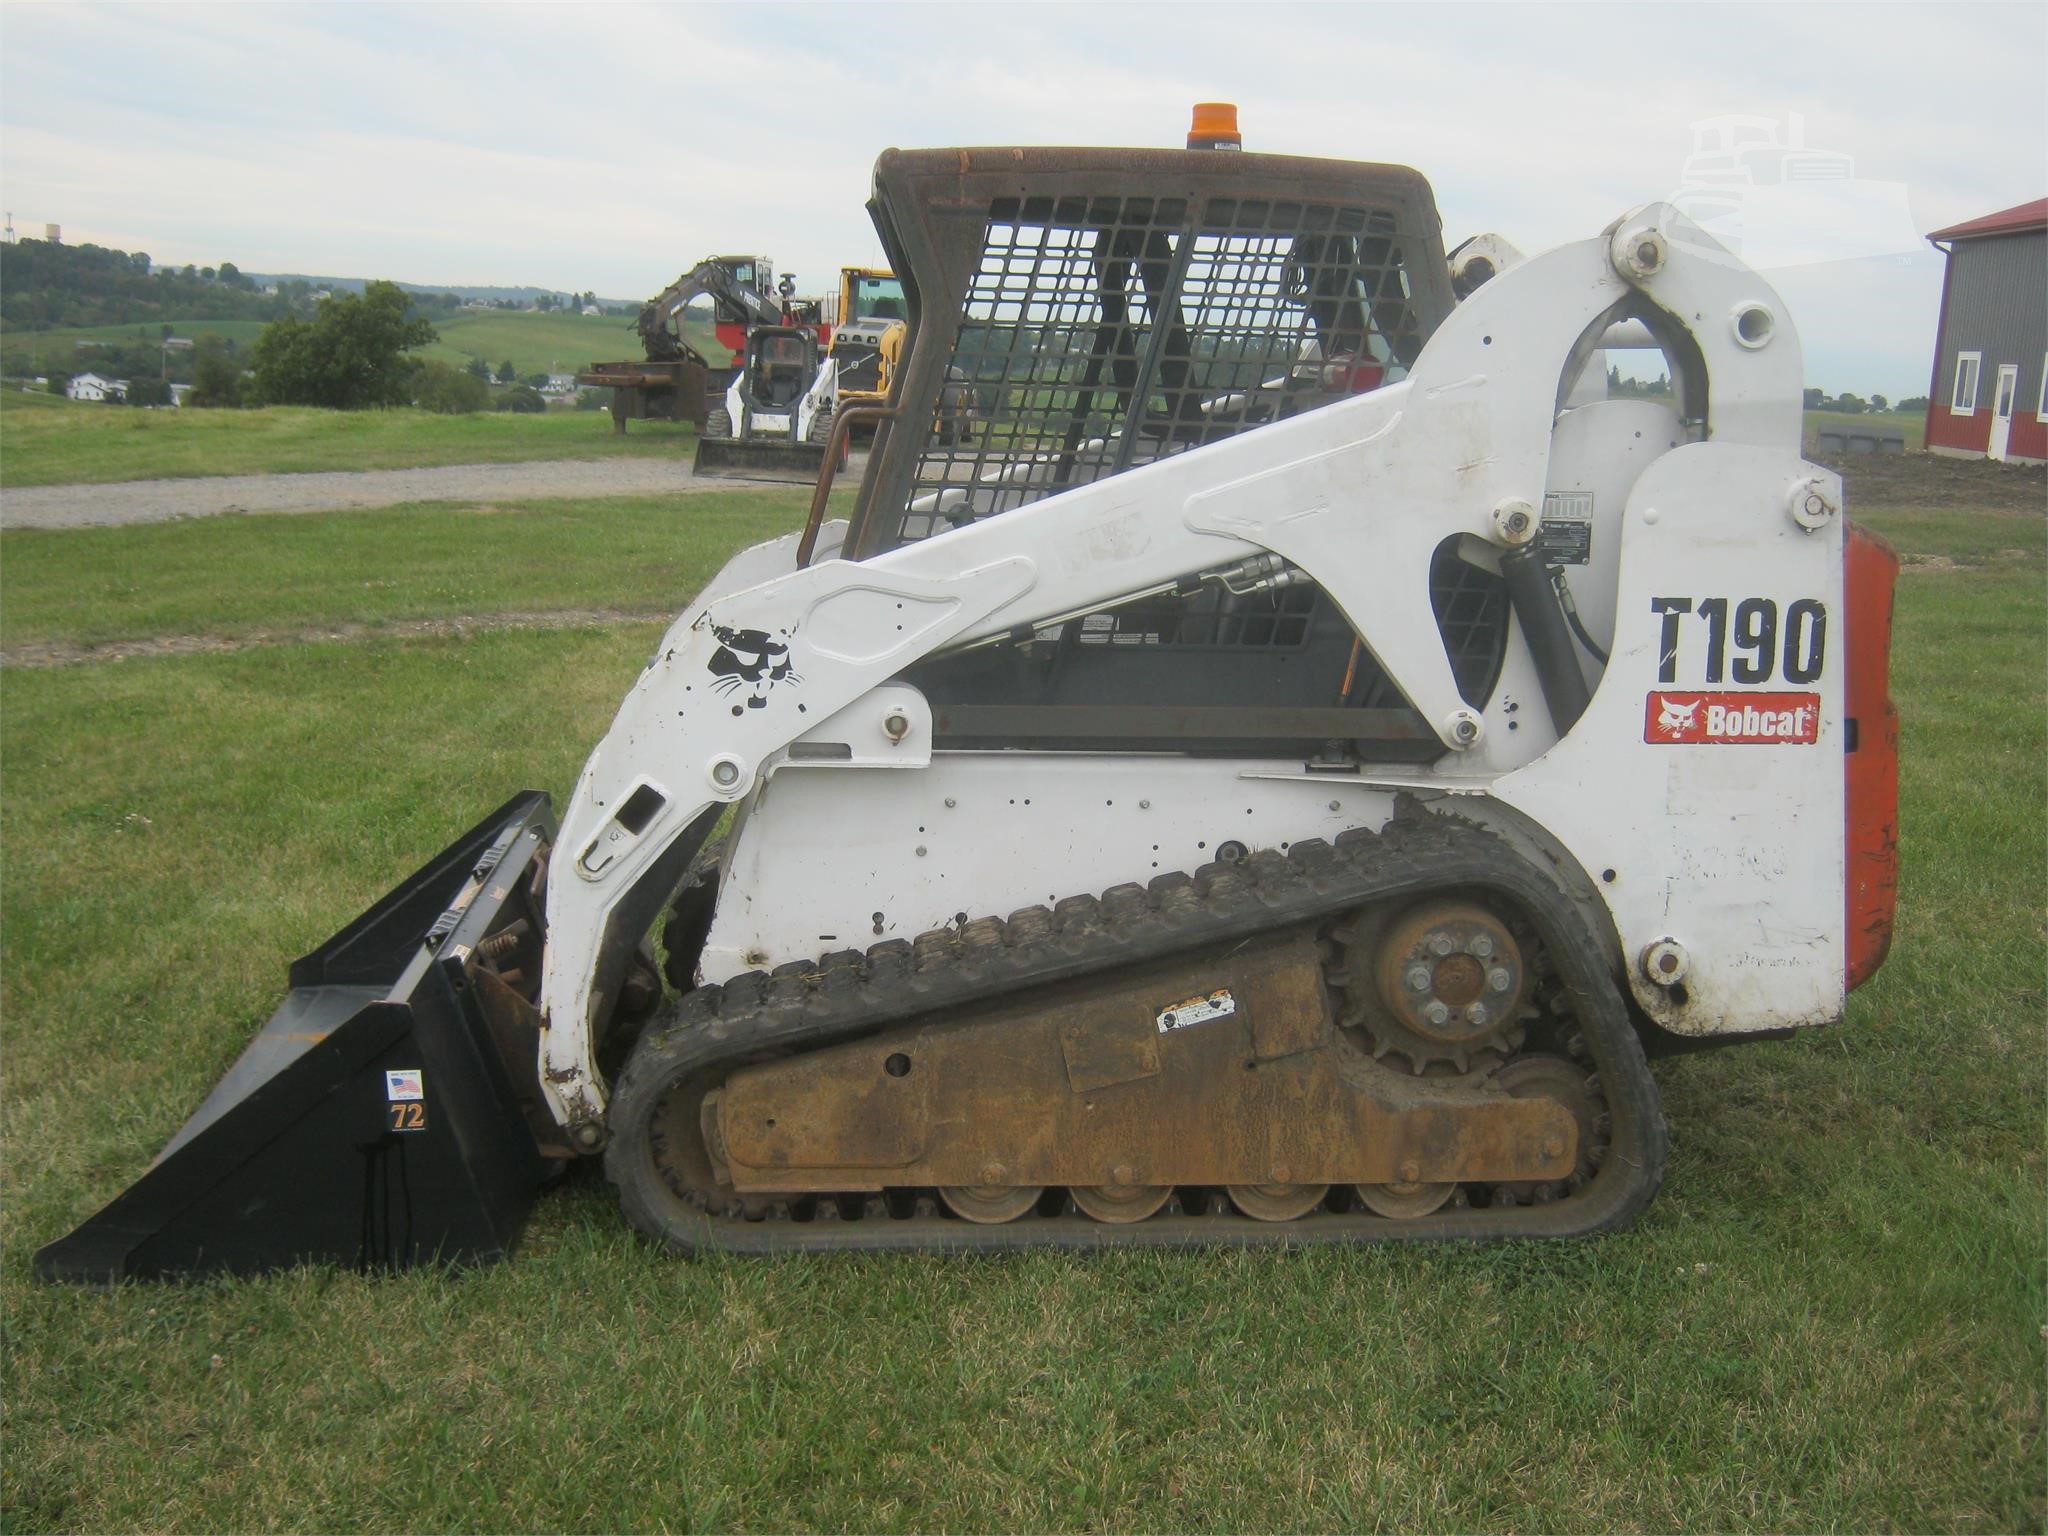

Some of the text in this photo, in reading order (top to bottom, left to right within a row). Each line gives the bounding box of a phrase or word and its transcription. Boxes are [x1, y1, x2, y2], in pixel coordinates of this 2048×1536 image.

[1651, 597, 1826, 684] T190
[1706, 705, 1804, 736] Bobcat
[391, 1103, 424, 1128] 72
